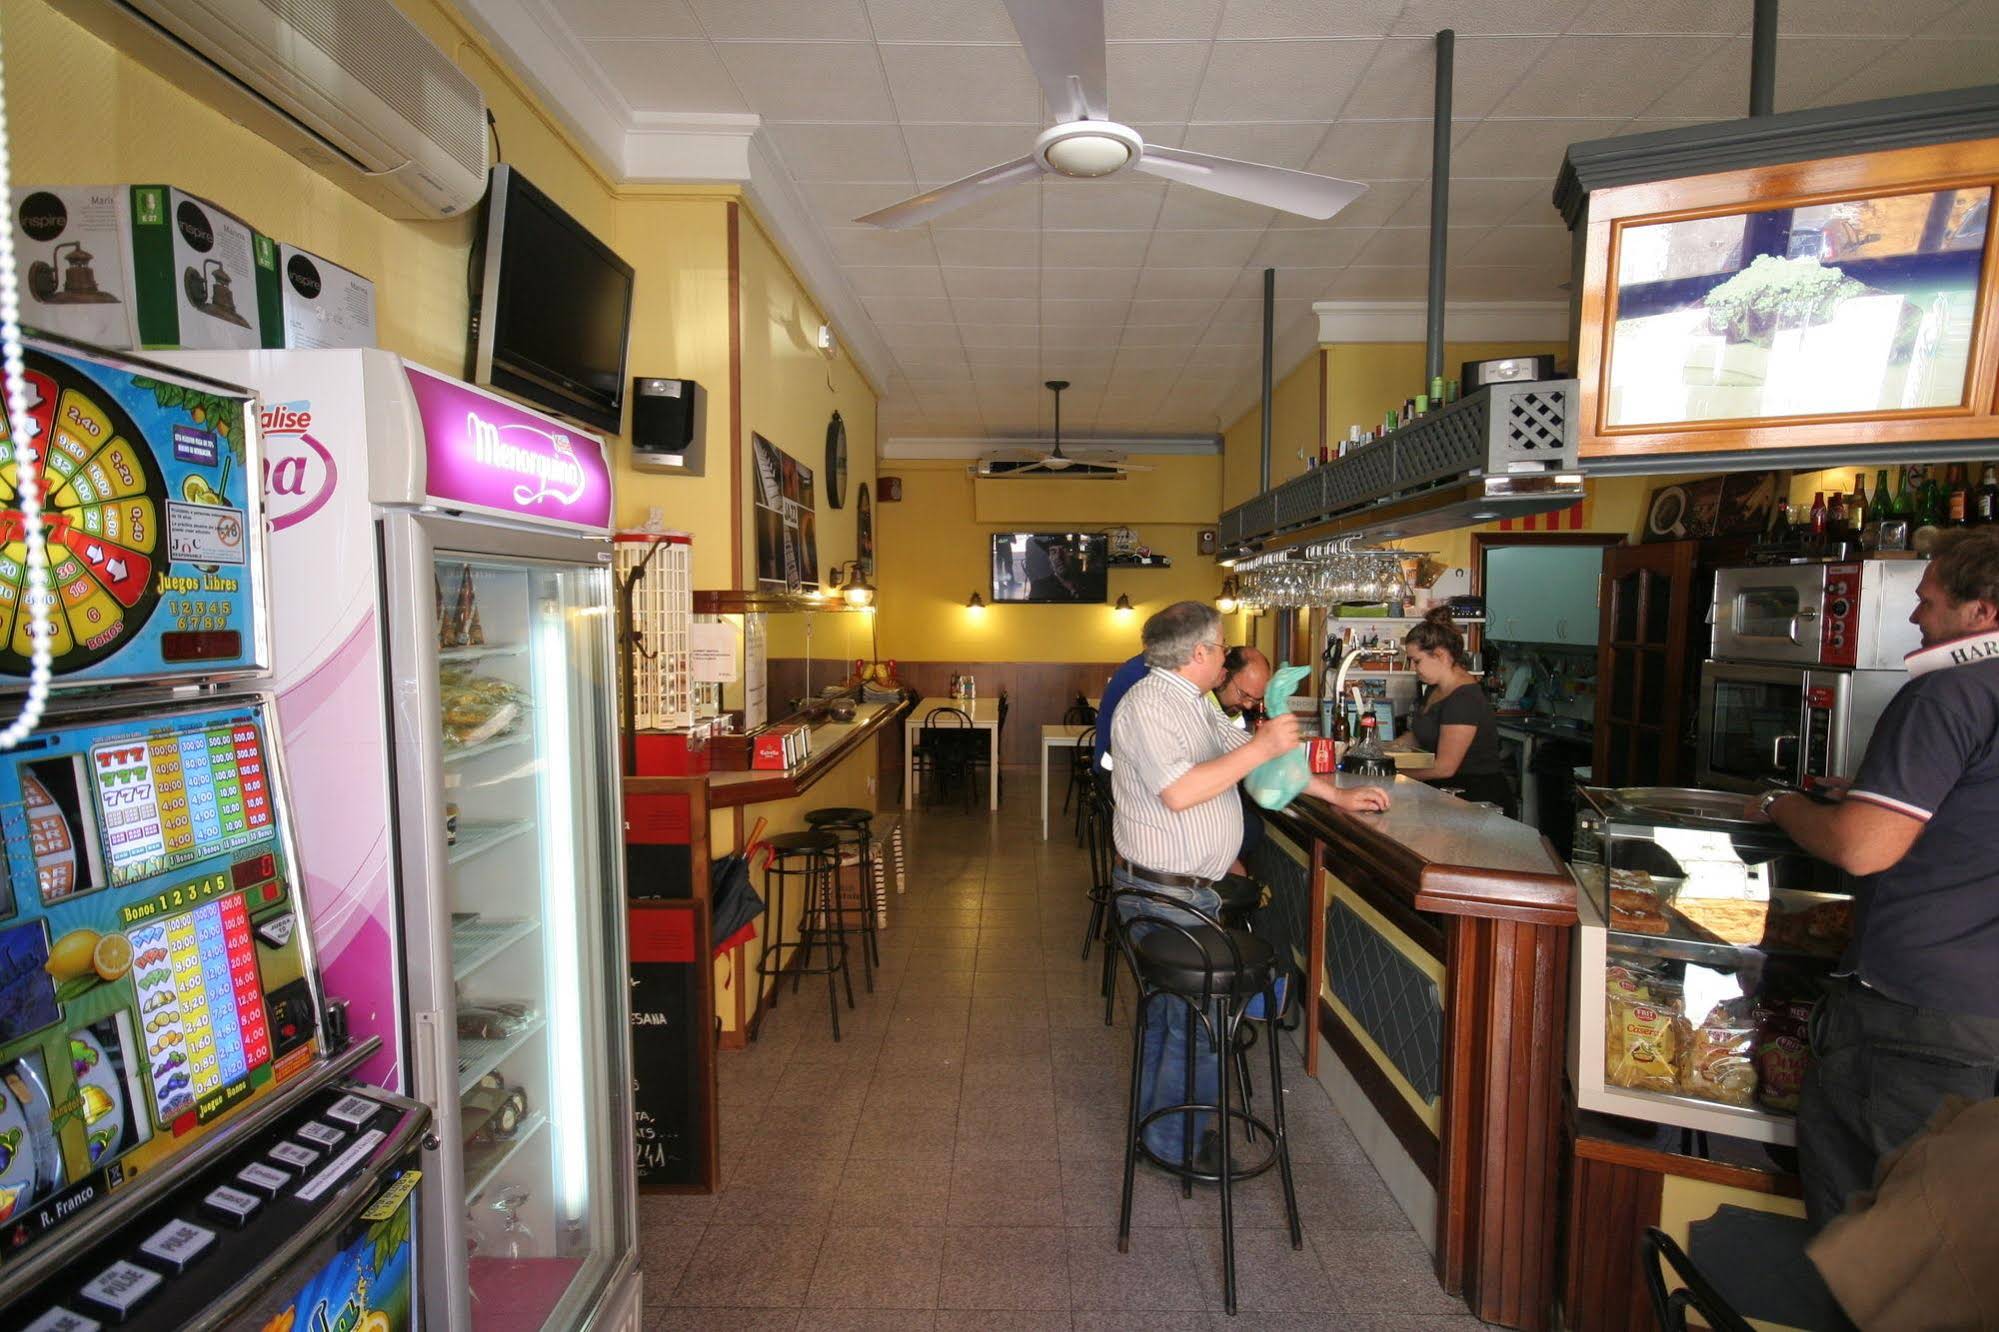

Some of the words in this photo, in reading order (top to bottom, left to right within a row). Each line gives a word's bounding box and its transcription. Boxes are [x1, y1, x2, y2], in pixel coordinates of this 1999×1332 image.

[21, 215, 66, 228] inspire
[178, 219, 213, 244] inspire
[290, 271, 320, 290] inspire
[67, 406, 100, 437] 2,40
[261, 406, 312, 430] alise
[57, 434, 87, 461] 9,60
[52, 454, 73, 475] 32
[110, 450, 135, 487] 3,20
[73, 474, 93, 503] 100
[56, 560, 78, 580] 30
[157, 571, 199, 595] Juegos
[203, 573, 237, 592] Libres
[87, 606, 101, 623] 6
[170, 601, 178, 615] 1
[182, 601, 192, 615] 2
[196, 601, 206, 615] 3
[209, 601, 219, 615] 4
[222, 601, 232, 615] 5
[86, 620, 125, 651] BONOS
[177, 617, 187, 631] 6
[191, 616, 201, 630] 7
[204, 616, 214, 630] 8
[216, 616, 227, 629] 9
[150, 743, 178, 757] 100,00
[181, 739, 205, 752] 300,00
[208, 735, 232, 748] 500,00
[233, 731, 255, 744] 500,00
[155, 761, 179, 775] 40,00
[184, 756, 208, 770] 80,00
[211, 752, 234, 765] 200,00
[236, 747, 258, 760] 300,00
[158, 780, 182, 794] 20,00
[187, 774, 211, 787] 40,00
[214, 769, 236, 781] 100,00
[240, 764, 260, 776] 150,00
[162, 797, 185, 812] 4,00
[191, 791, 214, 806] 4,00
[219, 785, 238, 798] 10,00
[243, 781, 262, 792] 10,00
[165, 815, 188, 830] 4,00
[193, 808, 217, 823] 4,00
[222, 802, 241, 816] 10,00
[246, 796, 265, 809] 10,00
[168, 832, 192, 847] 4,00
[197, 825, 220, 841] 4,00
[225, 819, 244, 833] 10,00
[249, 812, 268, 826] 10,00
[123, 903, 156, 923] Bonos
[159, 894, 168, 911] 1
[173, 889, 183, 906] 2
[188, 884, 198, 900] 3
[203, 879, 213, 894] 4
[216, 874, 225, 890] 5
[167, 914, 193, 932] 100,00
[220, 895, 242, 912] 500,00
[171, 935, 195, 952] 20,00
[199, 924, 221, 941] 60,00
[224, 914, 245, 931] 100,00
[175, 955, 198, 973] 8,00
[202, 943, 224, 961] 24,00
[228, 933, 249, 950] 40,00
[179, 975, 202, 993] 4,00
[206, 963, 227, 980] 12,00
[231, 951, 252, 969] 20,00
[182, 994, 205, 1014] 3,20
[209, 982, 230, 1001] 9,60
[234, 971, 255, 988] 16,00
[185, 1014, 209, 1034] 2,40
[212, 1002, 234, 1020] 7,20
[237, 990, 258, 1008] 12,00
[190, 1035, 211, 1054] 1,60
[215, 1021, 237, 1040] 4,80
[240, 1008, 261, 1027] 8,00
[193, 1055, 215, 1075] 0,80
[219, 1040, 241, 1059] 2,40
[244, 1027, 265, 1045] 4,00
[196, 1073, 219, 1094] 0,40
[223, 1060, 244, 1078] 1,20
[247, 1045, 267, 1064] 2,00
[225, 1080, 247, 1100] Bonos
[40, 1212, 54, 1228] R.
[55, 1185, 95, 1218] Franco
[159, 1225, 199, 1252] PULSE
[102, 1268, 145, 1298] PULSE
